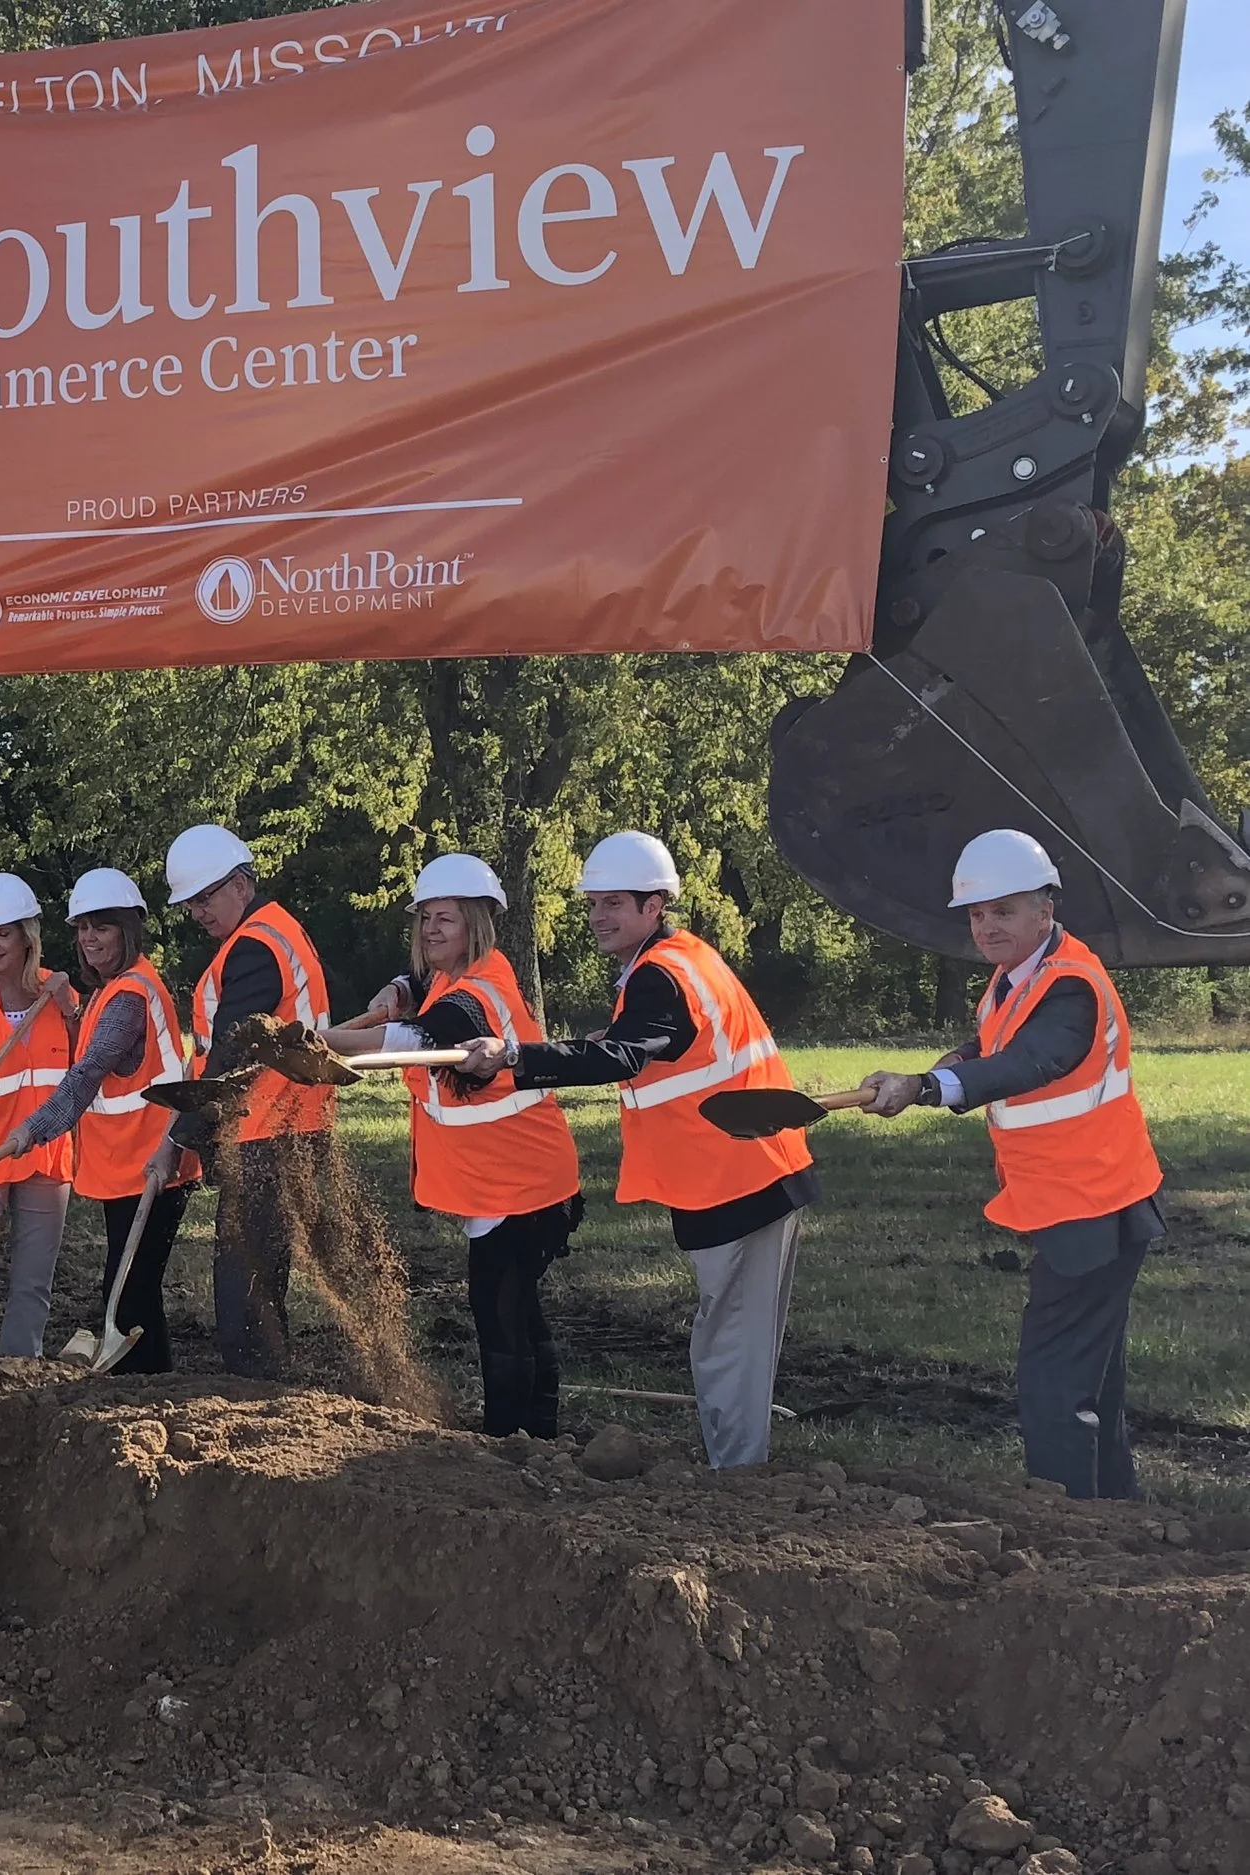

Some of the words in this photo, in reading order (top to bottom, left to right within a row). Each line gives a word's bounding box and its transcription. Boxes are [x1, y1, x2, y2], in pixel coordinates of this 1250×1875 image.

[200, 331, 417, 392] Center
[67, 496, 157, 521] PROUD
[169, 485, 308, 515] PARTNERS
[5, 591, 71, 605] ECONOMIC
[72, 586, 168, 602] DEVELOPMENT
[261, 590, 435, 617] DEVELOPMENT
[8, 608, 55, 622] Remarkable
[56, 607, 97, 620] Progress.
[99, 605, 127, 619] Simple
[128, 604, 163, 616] Process.
